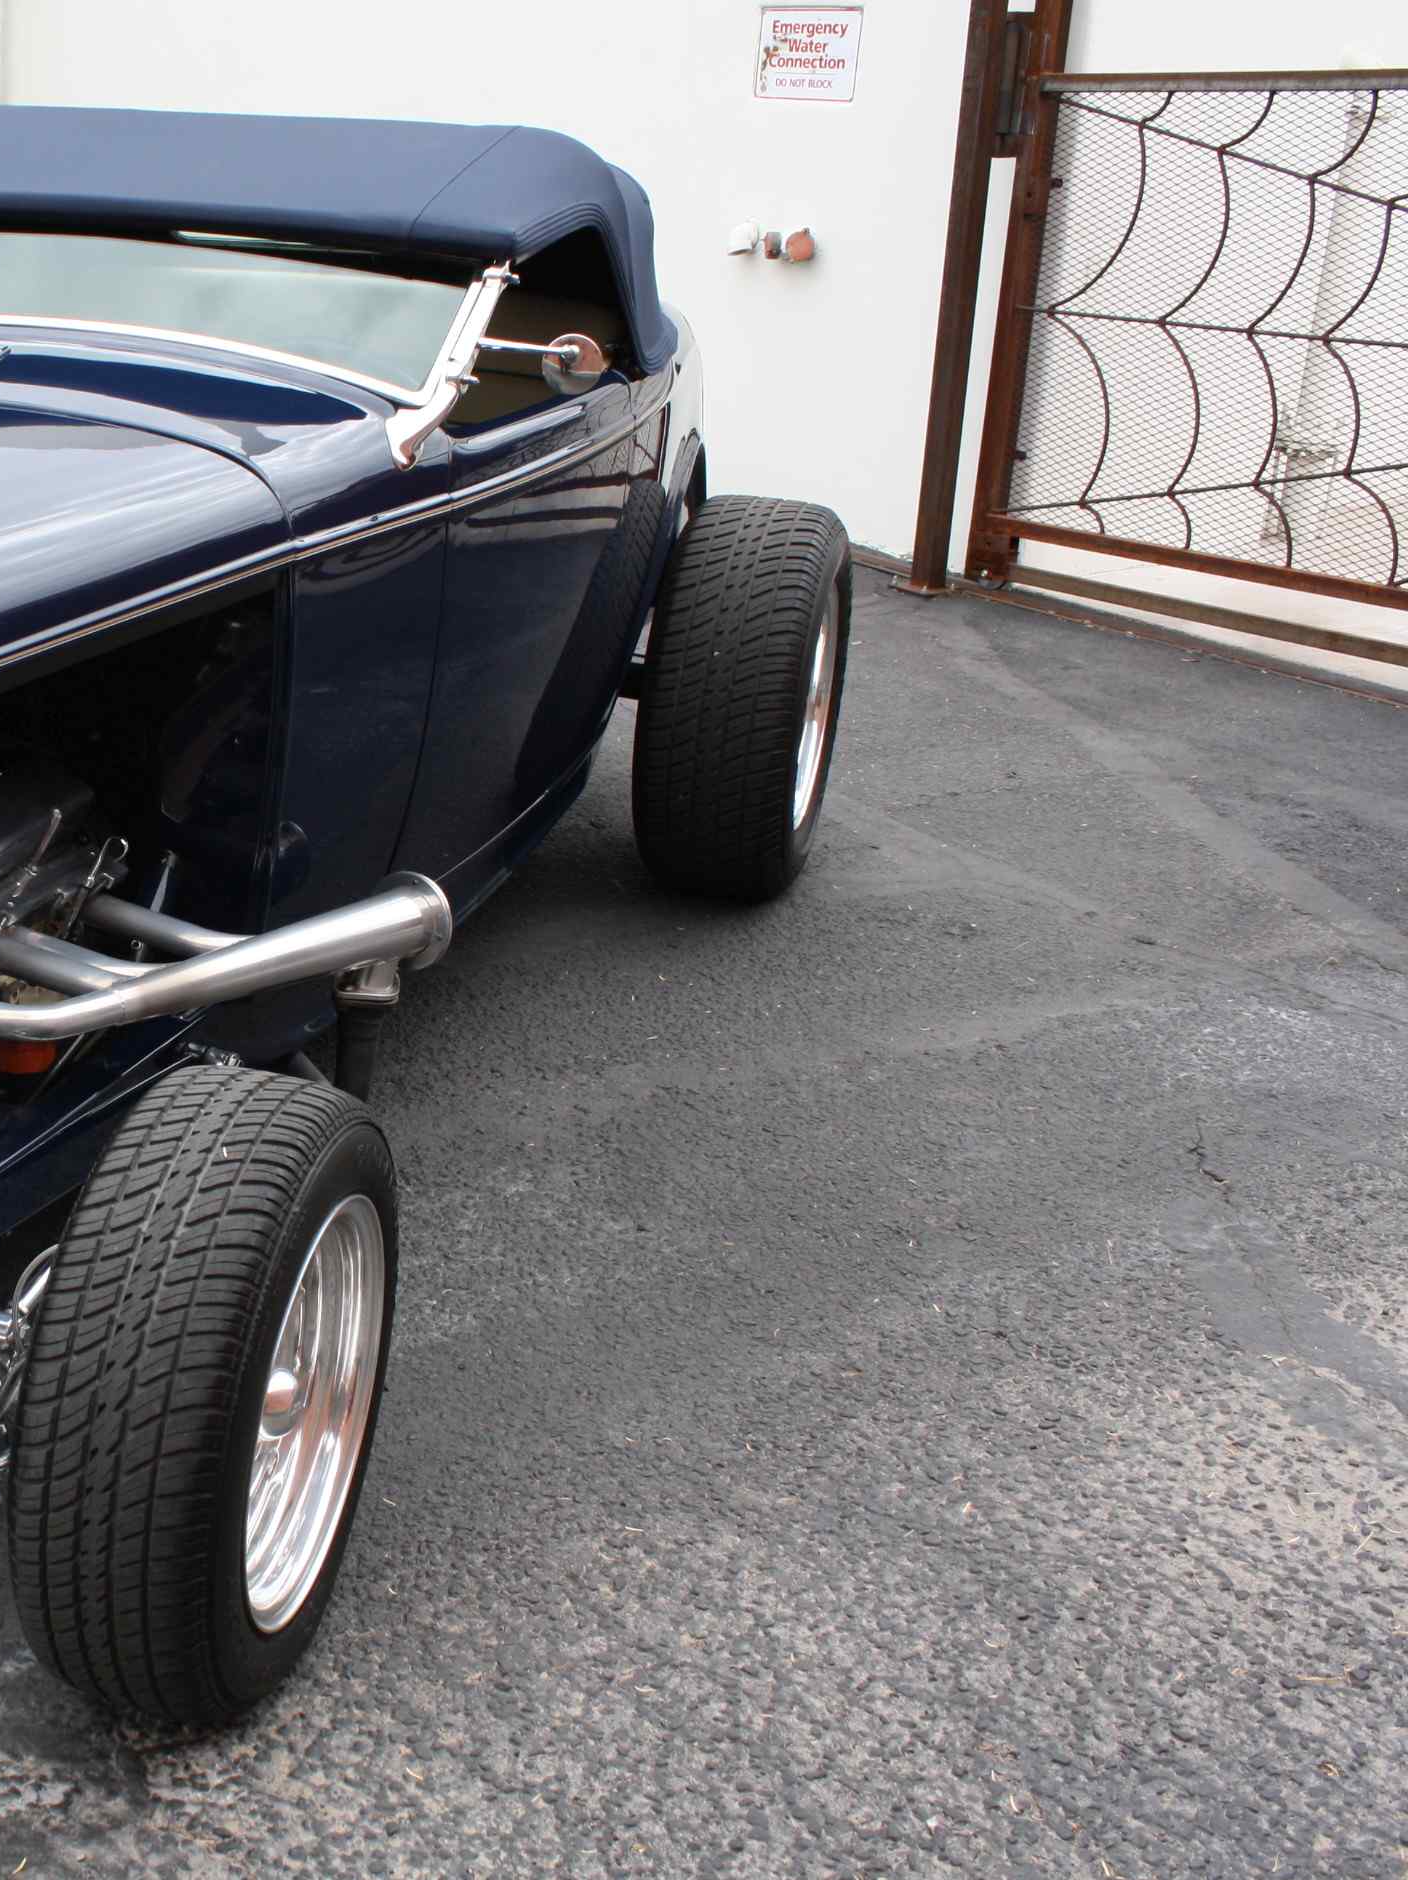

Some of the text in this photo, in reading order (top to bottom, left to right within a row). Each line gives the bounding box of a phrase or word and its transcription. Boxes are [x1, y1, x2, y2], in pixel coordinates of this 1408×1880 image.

[772, 20, 848, 38] Emergency
[788, 38, 828, 53] Water
[768, 54, 845, 69] Connection
[775, 78, 833, 88] DO NOT BLOCK
